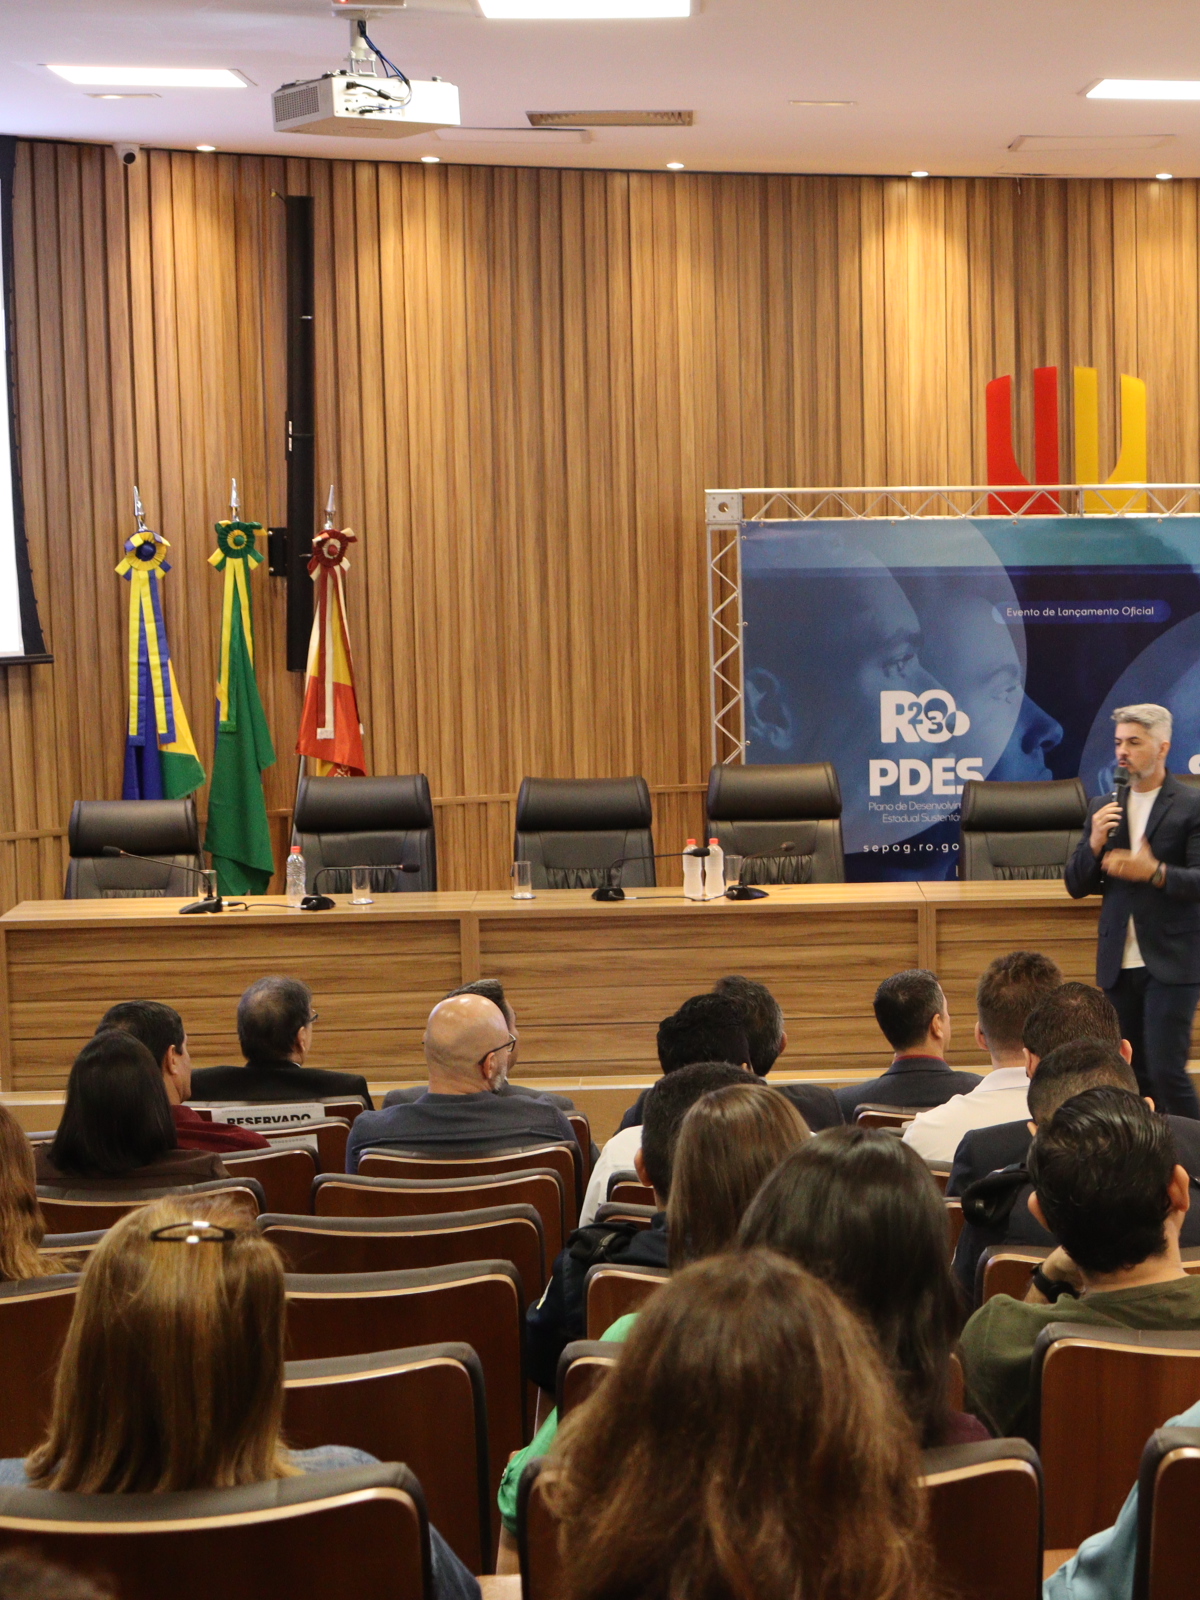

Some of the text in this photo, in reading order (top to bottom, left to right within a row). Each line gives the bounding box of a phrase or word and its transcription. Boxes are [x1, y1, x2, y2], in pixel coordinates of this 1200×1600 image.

[1006, 606, 1154, 618] Evento de Lançamento Oficial
[868, 757, 985, 797] PDES
[868, 801, 894, 811] Plano
[895, 801, 907, 811] de
[882, 812, 961, 823] Estadual Sustentá
[863, 842, 960, 855] sepog.ro.go
